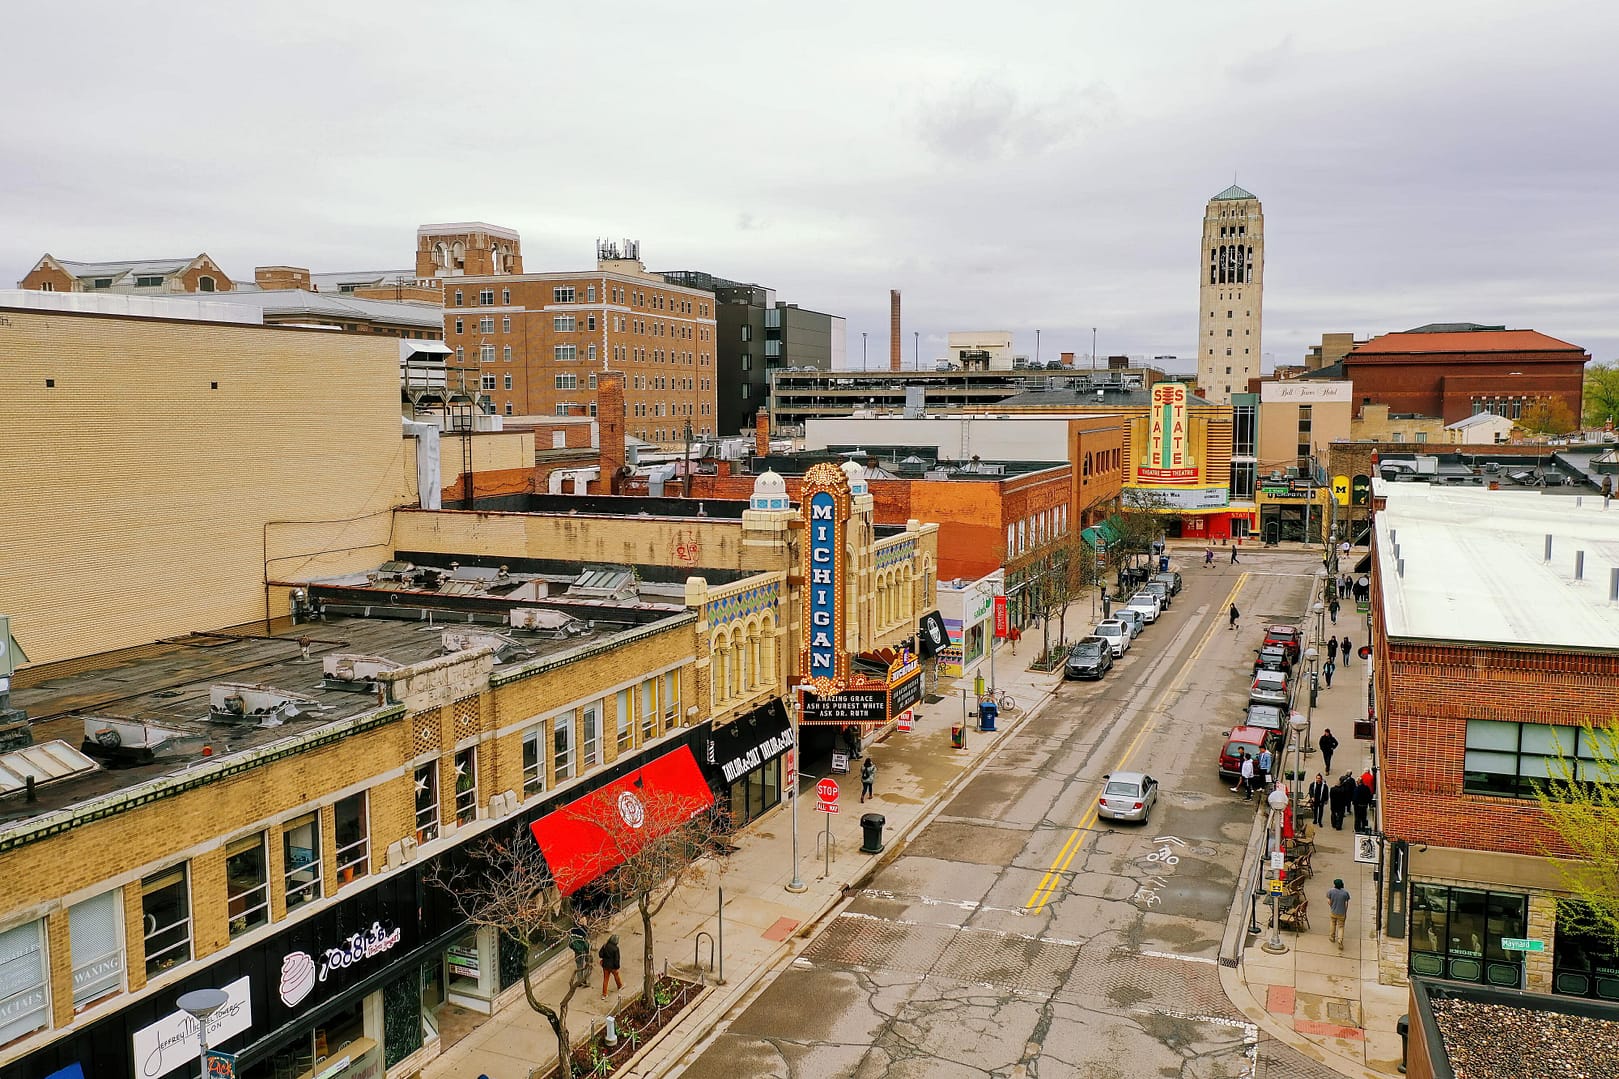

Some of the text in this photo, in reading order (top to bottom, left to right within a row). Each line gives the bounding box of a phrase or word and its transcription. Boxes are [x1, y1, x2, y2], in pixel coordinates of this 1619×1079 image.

[1153, 389, 1162, 465] STATE
[1173, 389, 1183, 465] STATE
[812, 504, 832, 668] MICHIGAN
[863, 702, 884, 710] WHITE
[817, 785, 838, 797] STOP
[818, 802, 827, 811] ALL
[1502, 940, 1530, 949] Maynard
[74, 957, 119, 984] WAXING
[0, 990, 43, 1018] ACIALS
[197, 1022, 222, 1040] SLON
